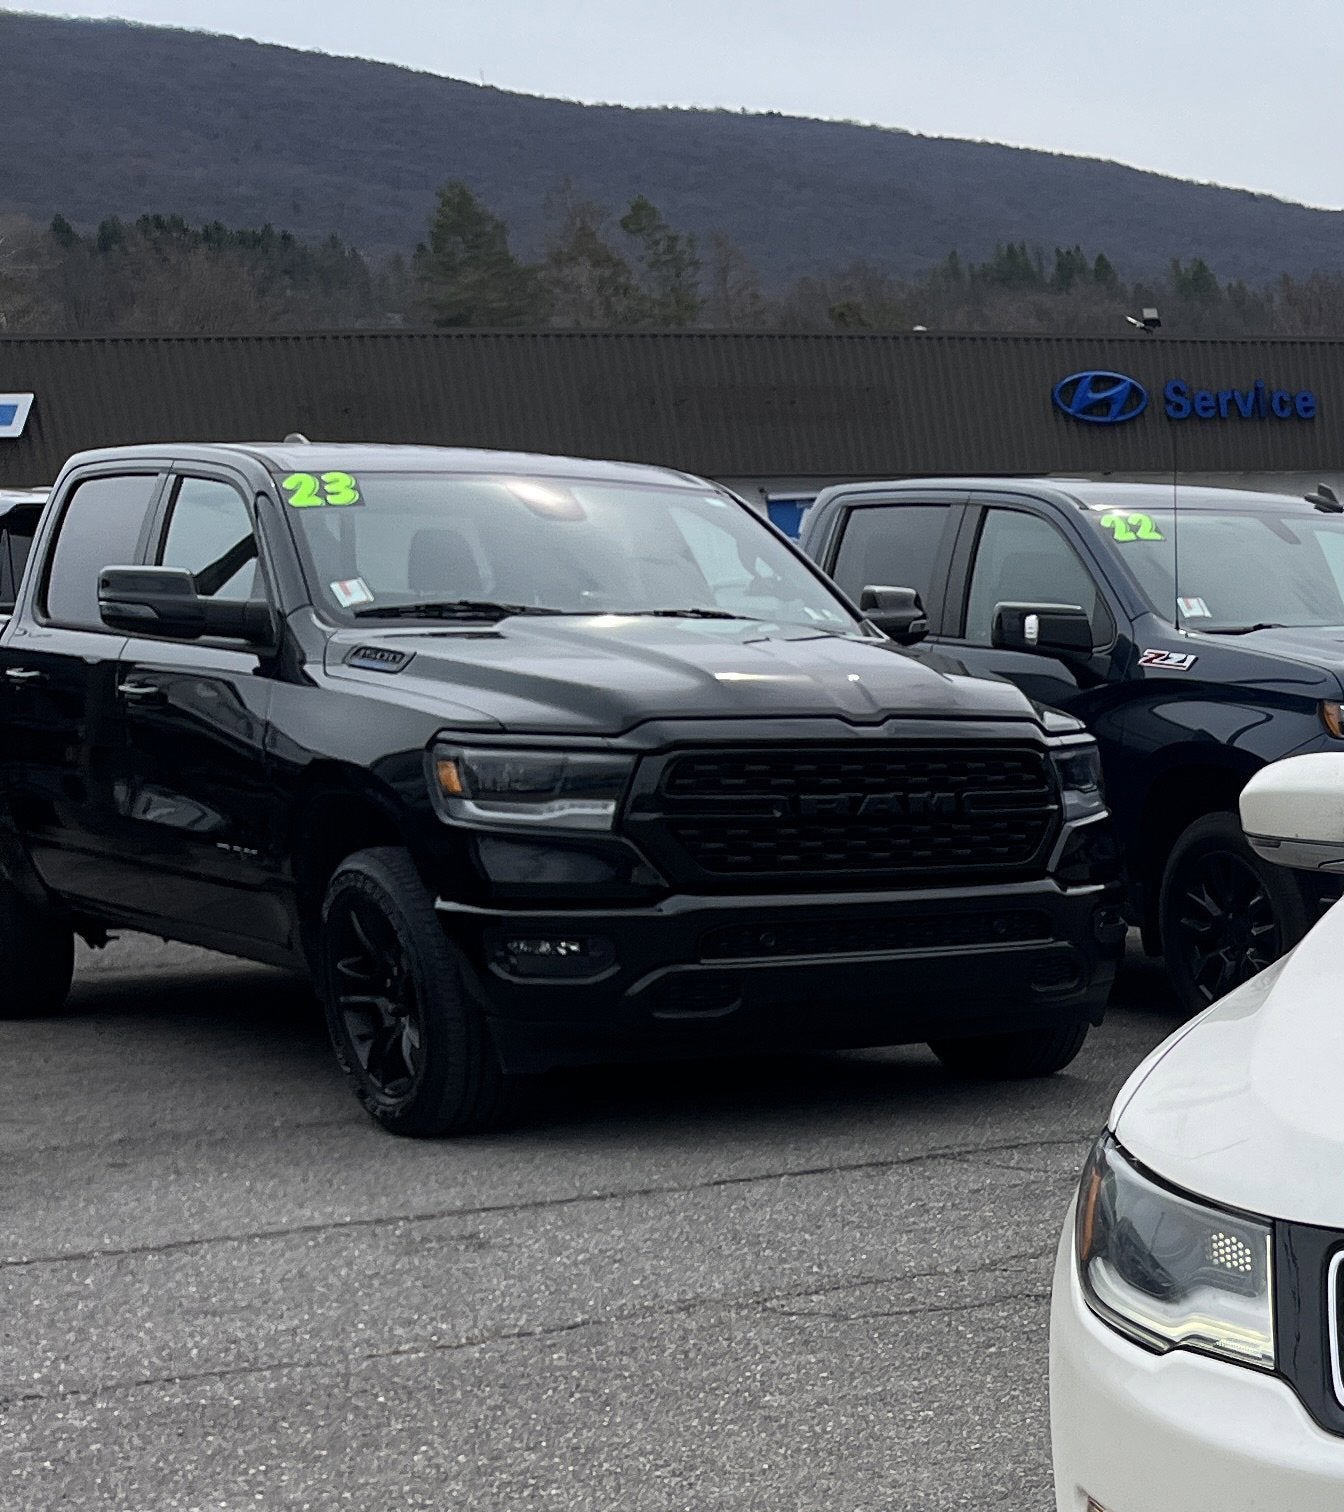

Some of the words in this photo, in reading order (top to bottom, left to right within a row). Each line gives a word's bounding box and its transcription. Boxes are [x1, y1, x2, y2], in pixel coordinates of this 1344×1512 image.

[1163, 378, 1318, 419] Service
[282, 471, 360, 508] 23
[1100, 513, 1166, 541] 22
